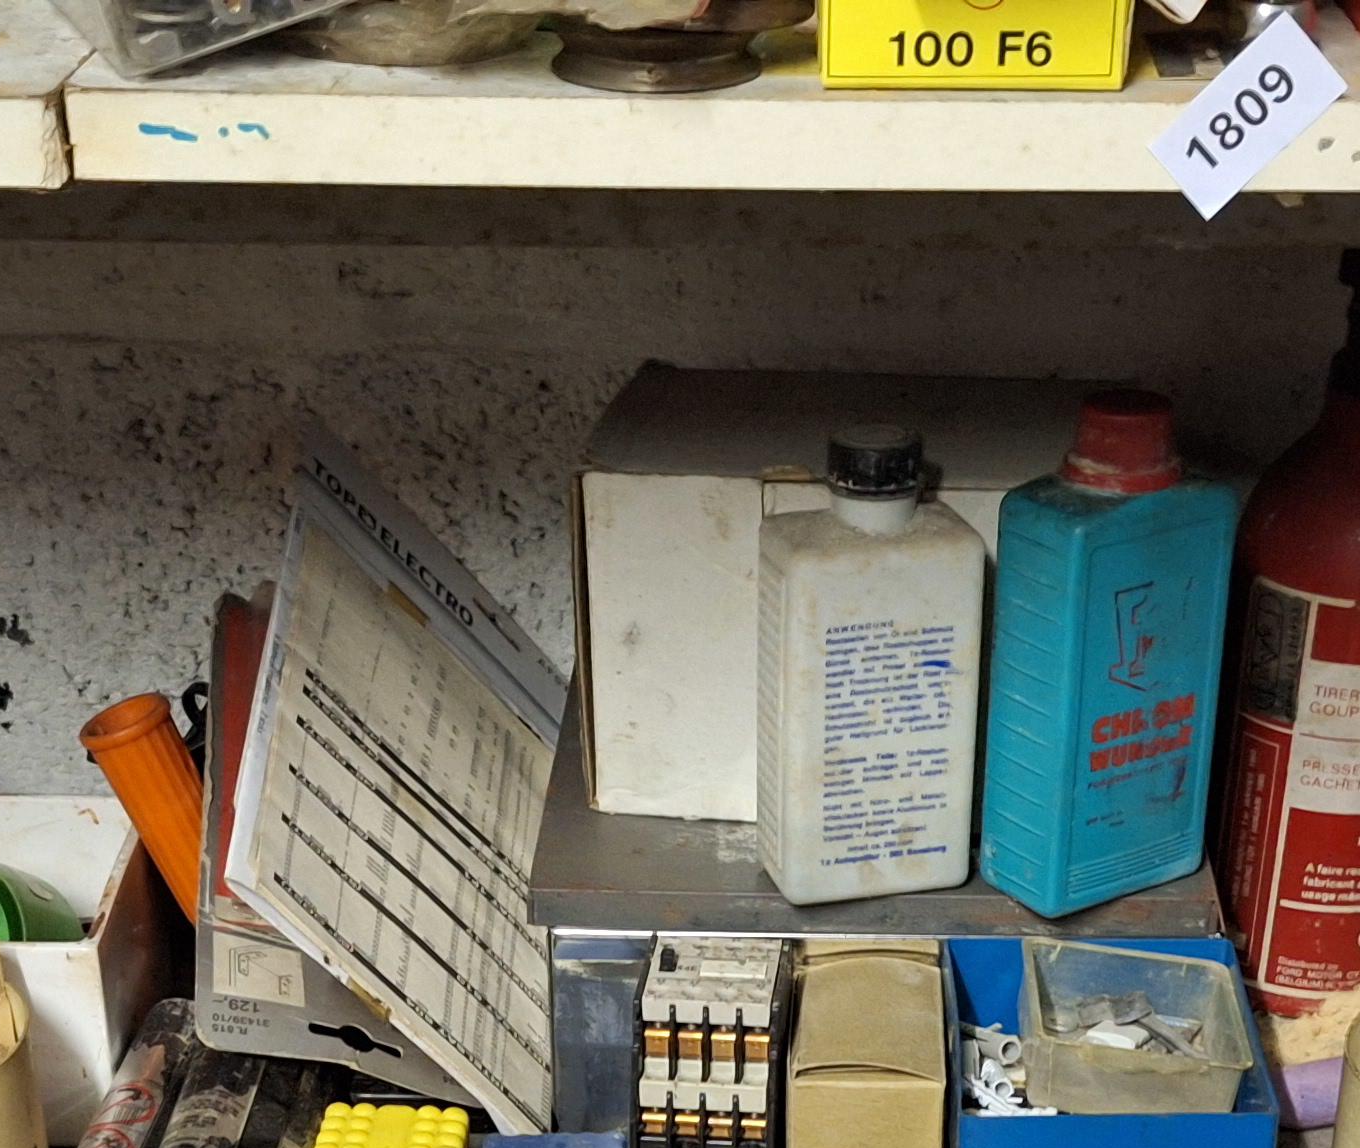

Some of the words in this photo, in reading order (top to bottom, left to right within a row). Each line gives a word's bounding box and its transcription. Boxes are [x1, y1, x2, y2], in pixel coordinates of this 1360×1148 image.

[888, 31, 973, 67] 100
[997, 31, 1052, 67] F6
[1185, 64, 1296, 169] 1809
[1314, 684, 1360, 702] TIRER
[1305, 862, 1315, 873] A
[1317, 863, 1344, 876] faire
[1303, 875, 1355, 889] fabricant
